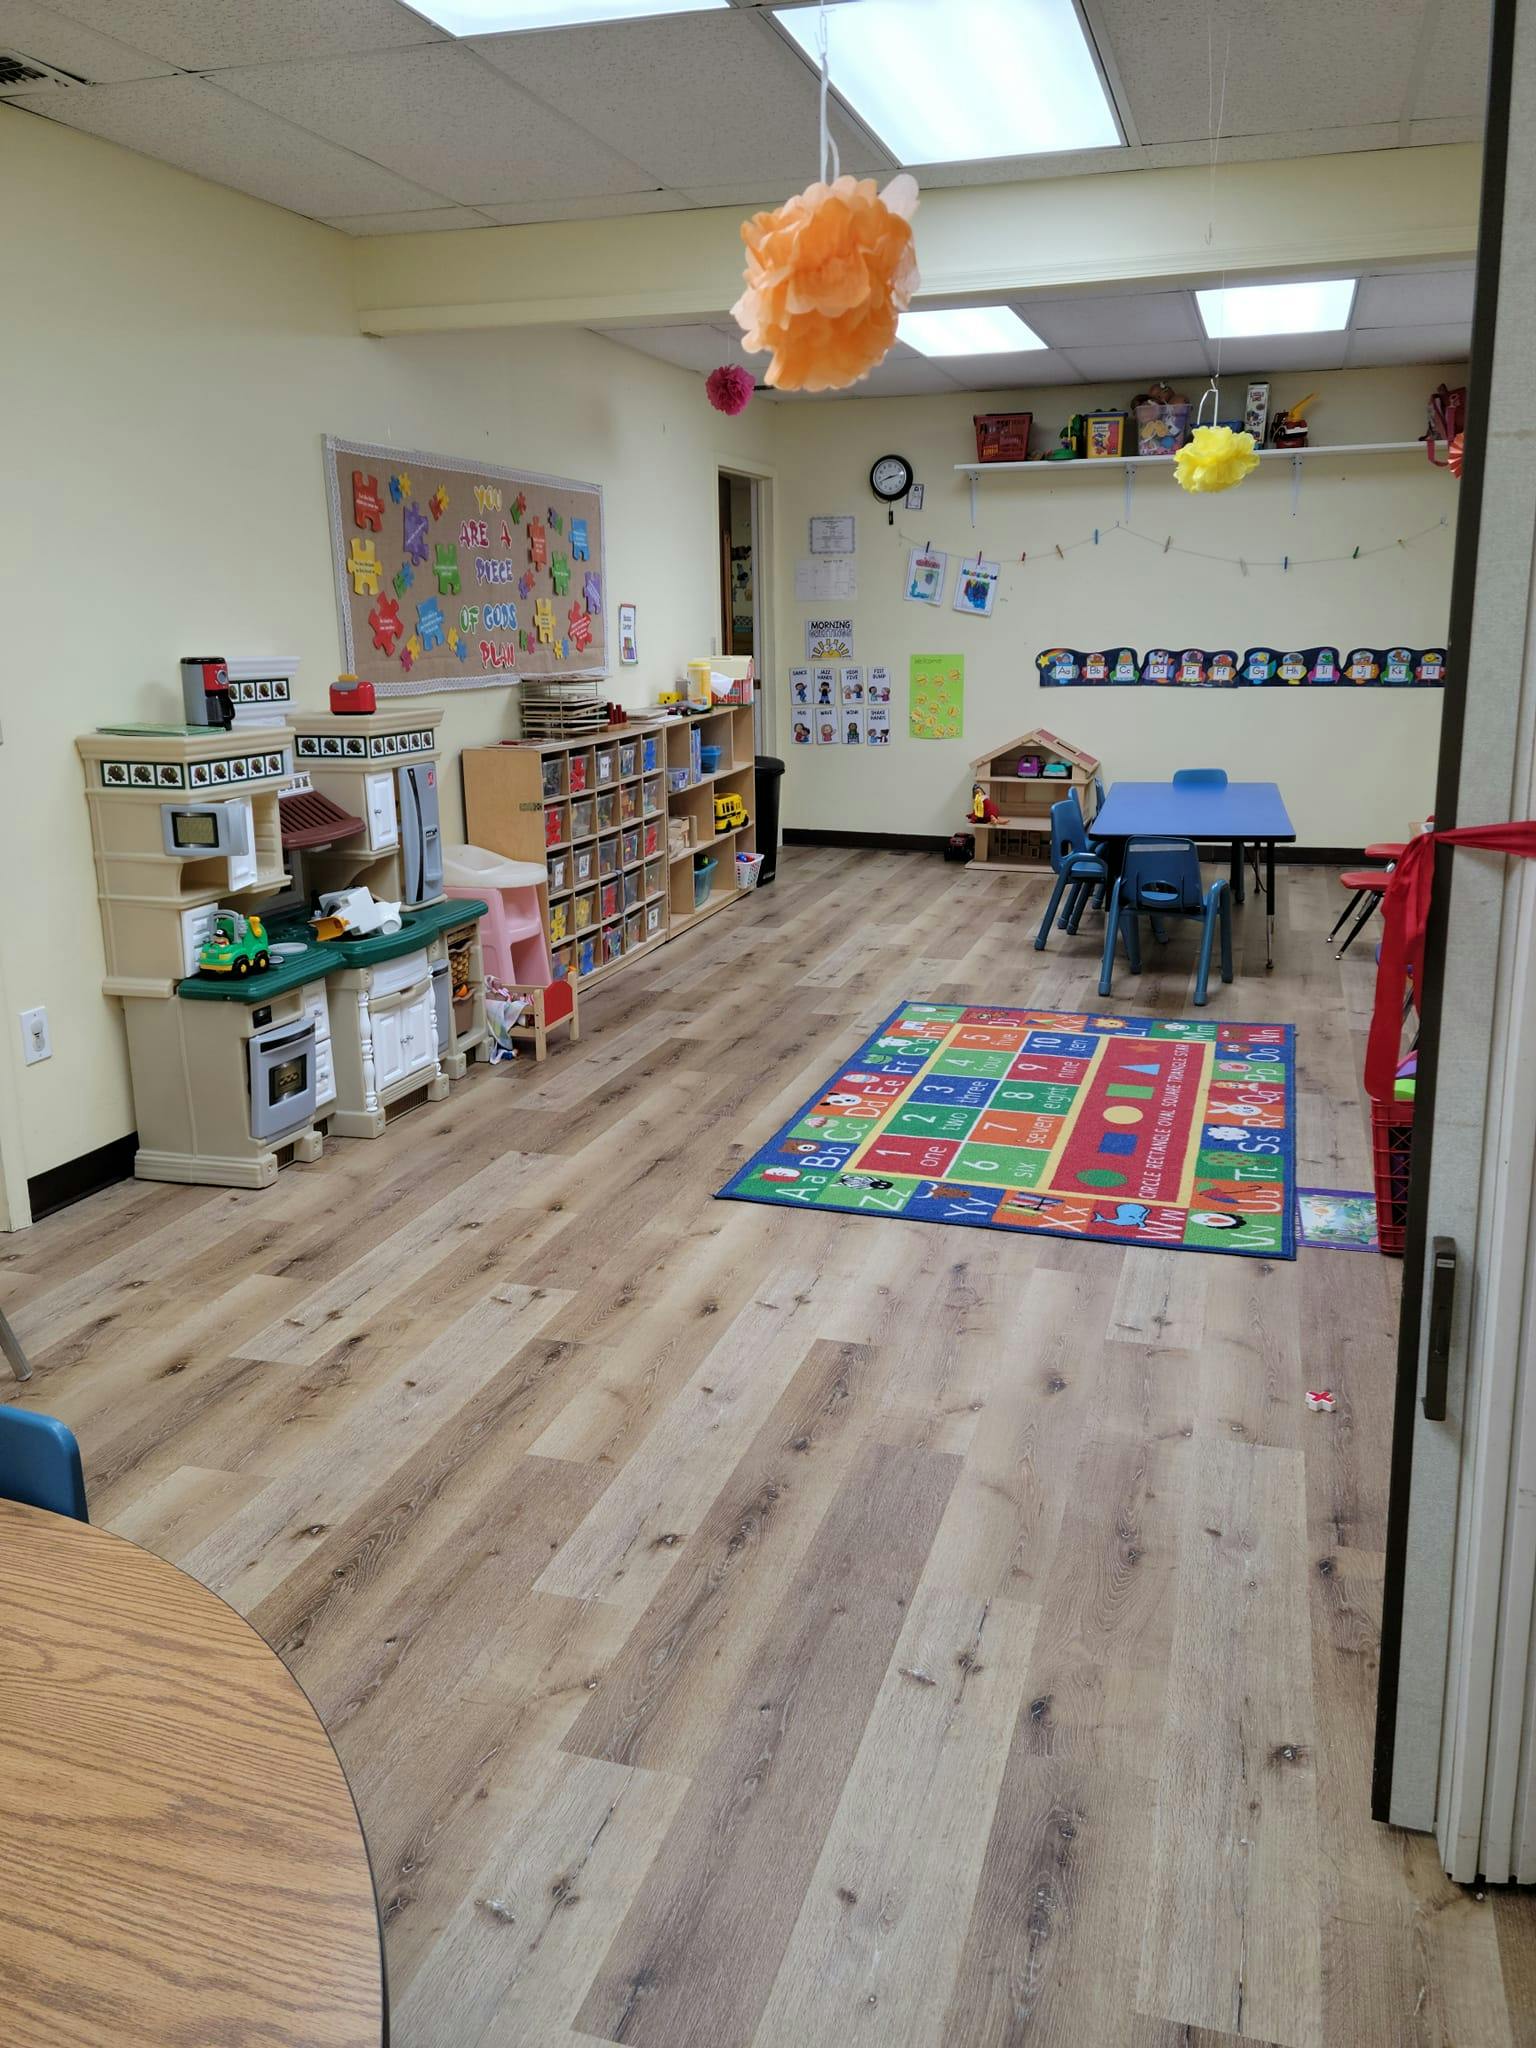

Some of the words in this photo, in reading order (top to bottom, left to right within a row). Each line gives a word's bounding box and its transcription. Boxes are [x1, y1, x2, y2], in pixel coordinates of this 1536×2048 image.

[474, 485, 502, 513] YOU
[459, 519, 489, 549] ARE
[500, 520, 512, 549] A
[475, 556, 513, 586] PIECE
[460, 605, 480, 634] OF
[483, 603, 518, 631] GODS
[810, 621, 850, 630] MORNING
[479, 640, 515, 669] PLAN
[1089, 666, 1101, 674] Bb
[1152, 665, 1165, 674] Dd
[1184, 666, 1196, 675] Ee
[1216, 668, 1227, 676] Ff
[1252, 667, 1265, 678] Gg
[1286, 667, 1298, 675] Hh
[1391, 667, 1403, 676] Kk
[1031, 1037, 1061, 1049] 10
[1248, 1029, 1280, 1043] Nn
[897, 1038, 939, 1056] Gg
[1065, 1039, 1088, 1052] ten
[1174, 1044, 1190, 1057] STAR
[944, 1058, 975, 1068] 4
[1245, 1048, 1280, 1062] Oo
[881, 1060, 921, 1074] Ff
[973, 1056, 1004, 1073] four
[1017, 1063, 1048, 1071] 9
[1055, 1061, 1081, 1079] nine
[1167, 1057, 1187, 1083] TRIANGLE
[1244, 1068, 1285, 1083] Pp
[863, 1080, 905, 1096] Ee
[923, 1085, 955, 1094] 3
[953, 1080, 989, 1104] three
[1002, 1092, 1034, 1100] 8
[1161, 1084, 1181, 1107] SQUARE
[1039, 1086, 1071, 1110] eight
[1237, 1090, 1285, 1105] Qq
[843, 1100, 889, 1118] Dd
[902, 1113, 937, 1124] 2
[938, 1112, 968, 1131] two
[983, 1121, 1018, 1132] 7
[1157, 1110, 1175, 1127] OVAL
[1242, 1112, 1284, 1128] Rr
[823, 1122, 868, 1141] Cc
[1026, 1115, 1055, 1145] seven
[1146, 1129, 1171, 1169] RECTANGLE
[1237, 1135, 1281, 1154] Ss
[799, 1146, 850, 1168] Bb
[920, 1146, 948, 1167] one
[962, 1160, 999, 1171] 6
[1009, 1162, 1037, 1178] six
[1234, 1166, 1278, 1181] Tt
[775, 1174, 828, 1201] Aa
[1138, 1172, 1161, 1200] CIRCLE
[859, 1188, 911, 1211] Zz
[943, 1197, 998, 1216] Yy
[1237, 1190, 1281, 1212] Uu
[1039, 1205, 1090, 1232] Xx
[1136, 1209, 1186, 1239] Ww
[1229, 1224, 1276, 1248] Vv
